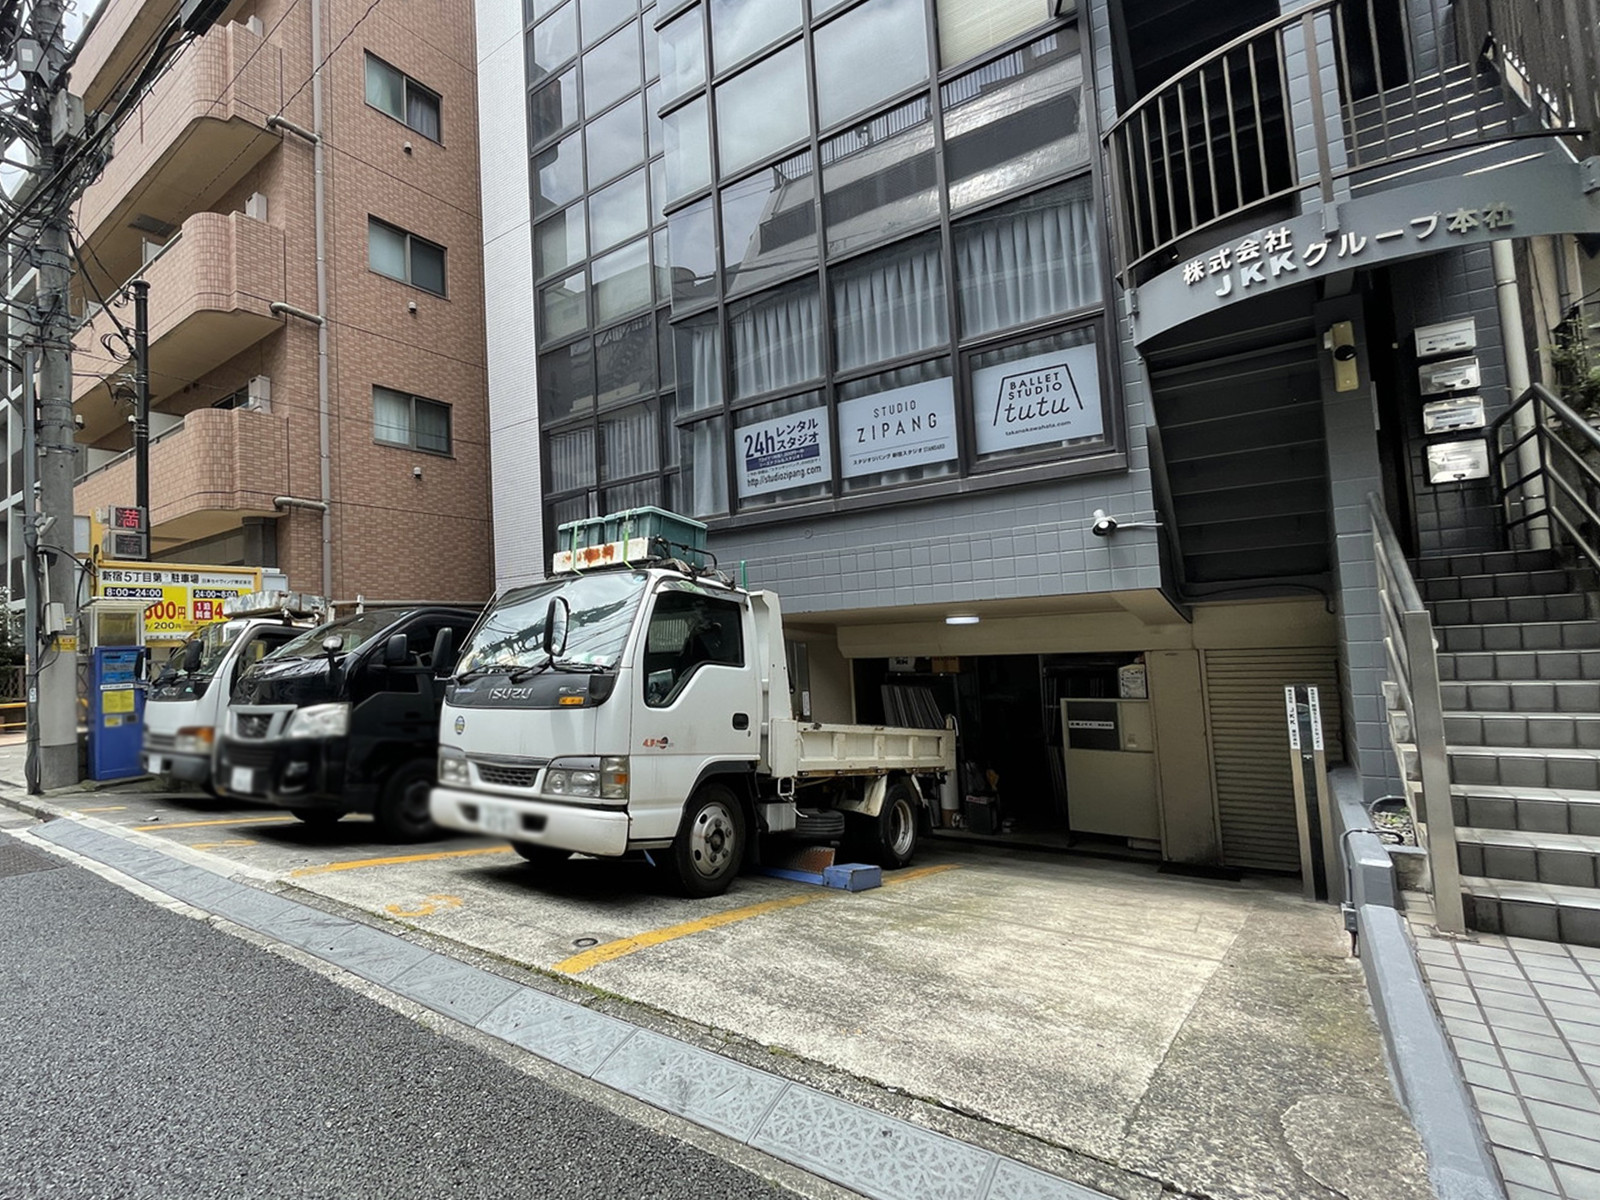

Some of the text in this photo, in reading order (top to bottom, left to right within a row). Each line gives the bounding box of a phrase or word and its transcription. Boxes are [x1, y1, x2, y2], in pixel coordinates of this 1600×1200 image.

[1182, 226, 1293, 286] 株式会社
[1010, 372, 1059, 390] BALLET
[1008, 382, 1062, 400] STUDIO
[873, 400, 917, 418] STUDIO
[1004, 396, 1070, 423] tutu
[776, 418, 819, 437] レンタル
[857, 412, 937, 443] ZIPANG
[744, 430, 775, 459] 24h
[777, 431, 819, 451] スタジオ
[488, 688, 533, 699] ISUZU
